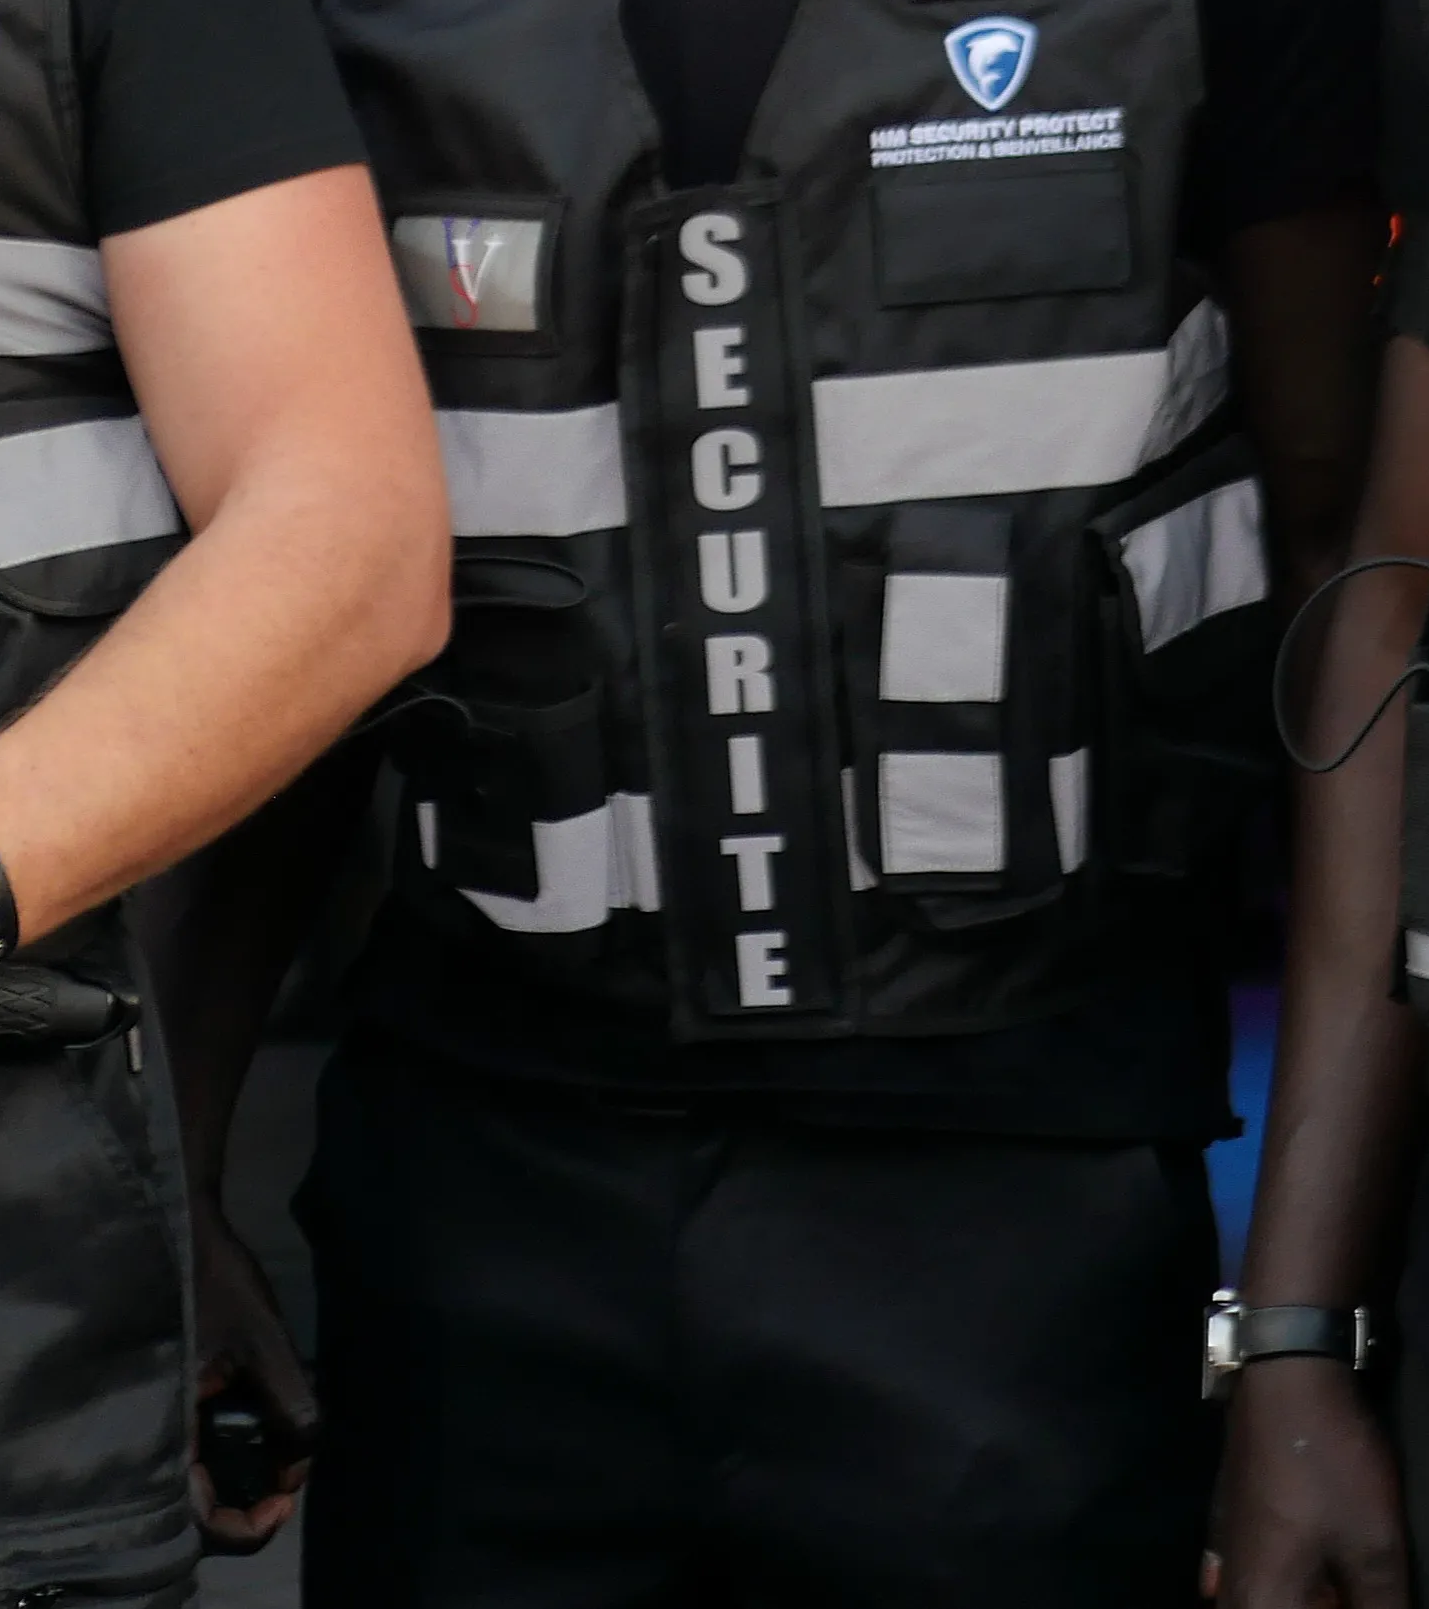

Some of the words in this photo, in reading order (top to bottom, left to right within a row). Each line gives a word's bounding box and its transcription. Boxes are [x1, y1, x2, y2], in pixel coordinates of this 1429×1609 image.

[871, 127, 907, 150] HM
[909, 117, 1018, 145] SECURITY
[1019, 107, 1123, 136] PROTECT
[872, 143, 976, 168] PROTECTION
[993, 132, 1124, 156] BIENVEILLANCE
[678, 211, 794, 1009] SECURITE
